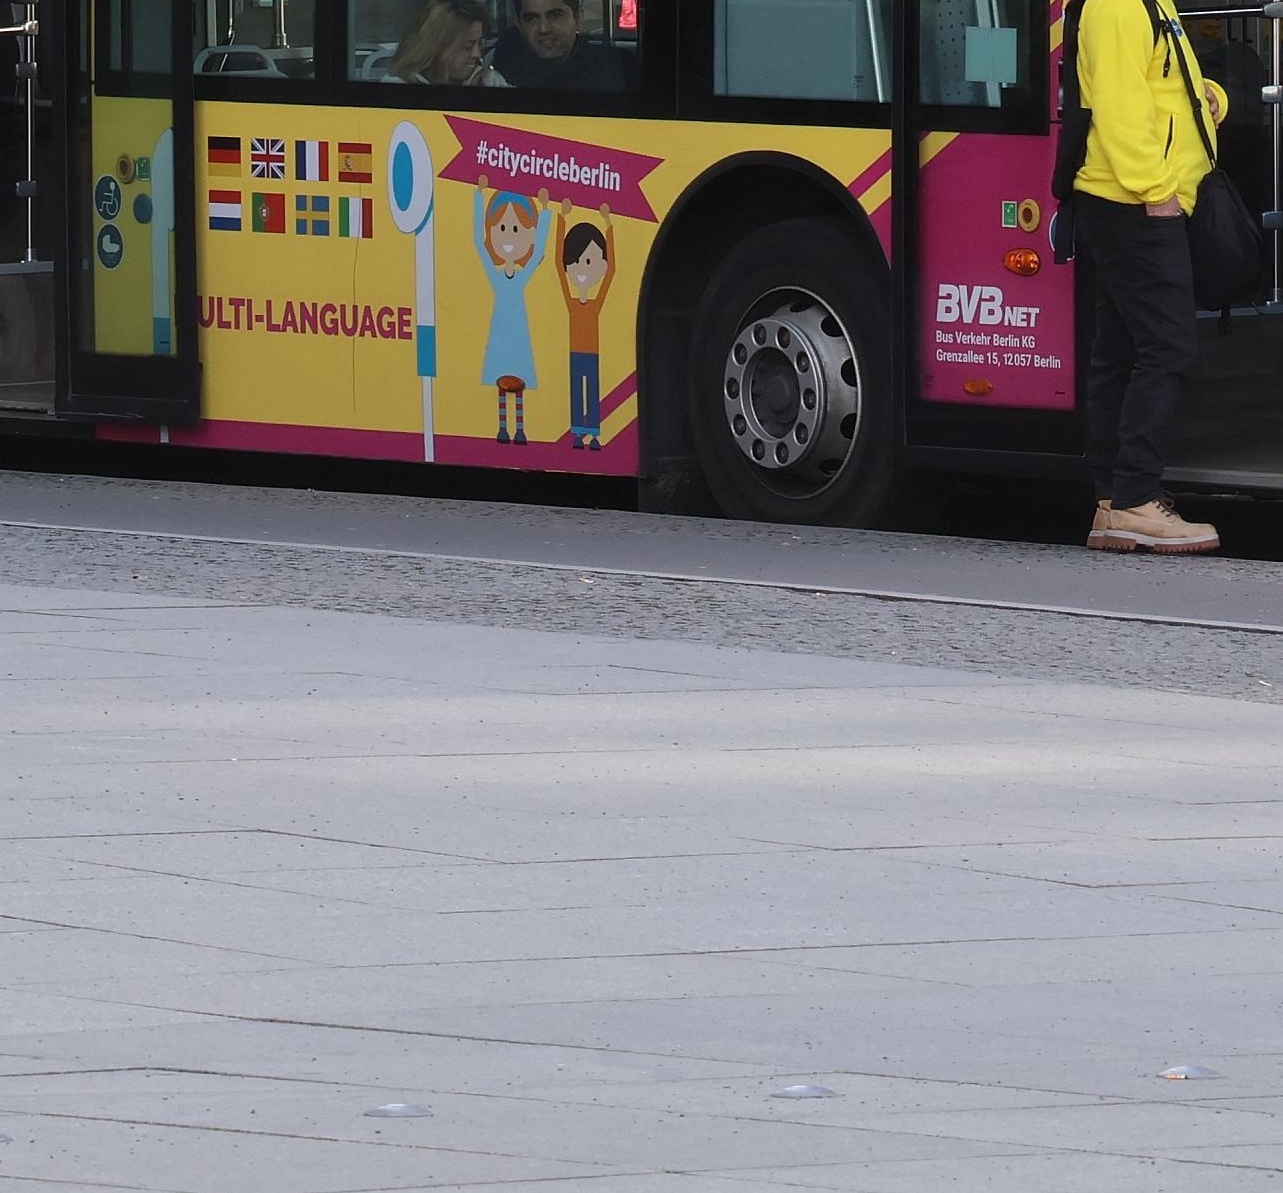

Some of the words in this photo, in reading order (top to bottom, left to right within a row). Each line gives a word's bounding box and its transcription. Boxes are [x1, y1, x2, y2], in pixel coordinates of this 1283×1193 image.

[476, 140, 621, 192] #citycircleberlin
[935, 329, 954, 344] Bus
[954, 331, 991, 347] Verkehr
[992, 333, 1020, 348] Berlin
[1021, 335, 1036, 349] KG
[936, 348, 985, 365] Grenzallee
[986, 352, 1001, 368] 15,
[1002, 353, 1032, 368] 12057
[1033, 354, 1062, 369] Berlin
